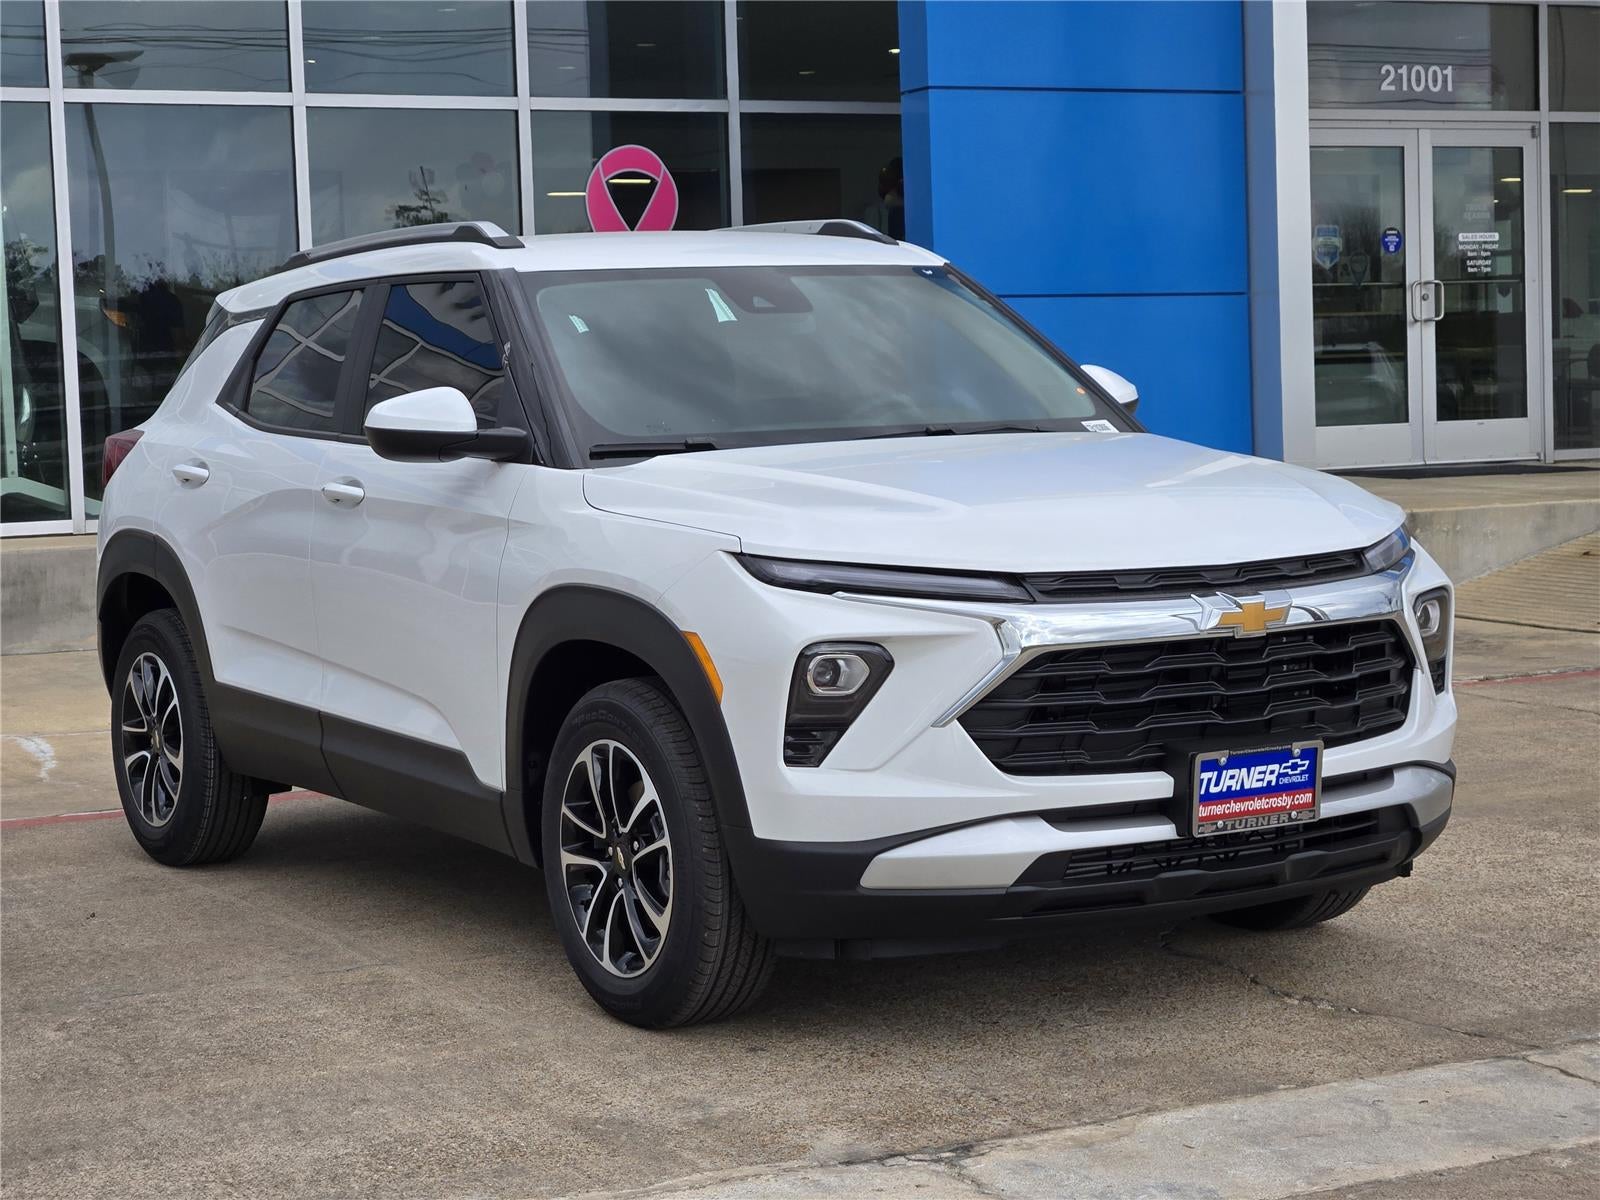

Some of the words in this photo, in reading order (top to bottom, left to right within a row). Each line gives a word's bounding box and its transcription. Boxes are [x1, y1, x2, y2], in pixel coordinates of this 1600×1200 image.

[1380, 64, 1453, 92] 21001
[1200, 764, 1280, 794] TURNER
[1279, 774, 1309, 784] CHEVROLET
[1198, 793, 1312, 816] turnerchevroletcrosby.com
[1226, 814, 1289, 829] TURNER
